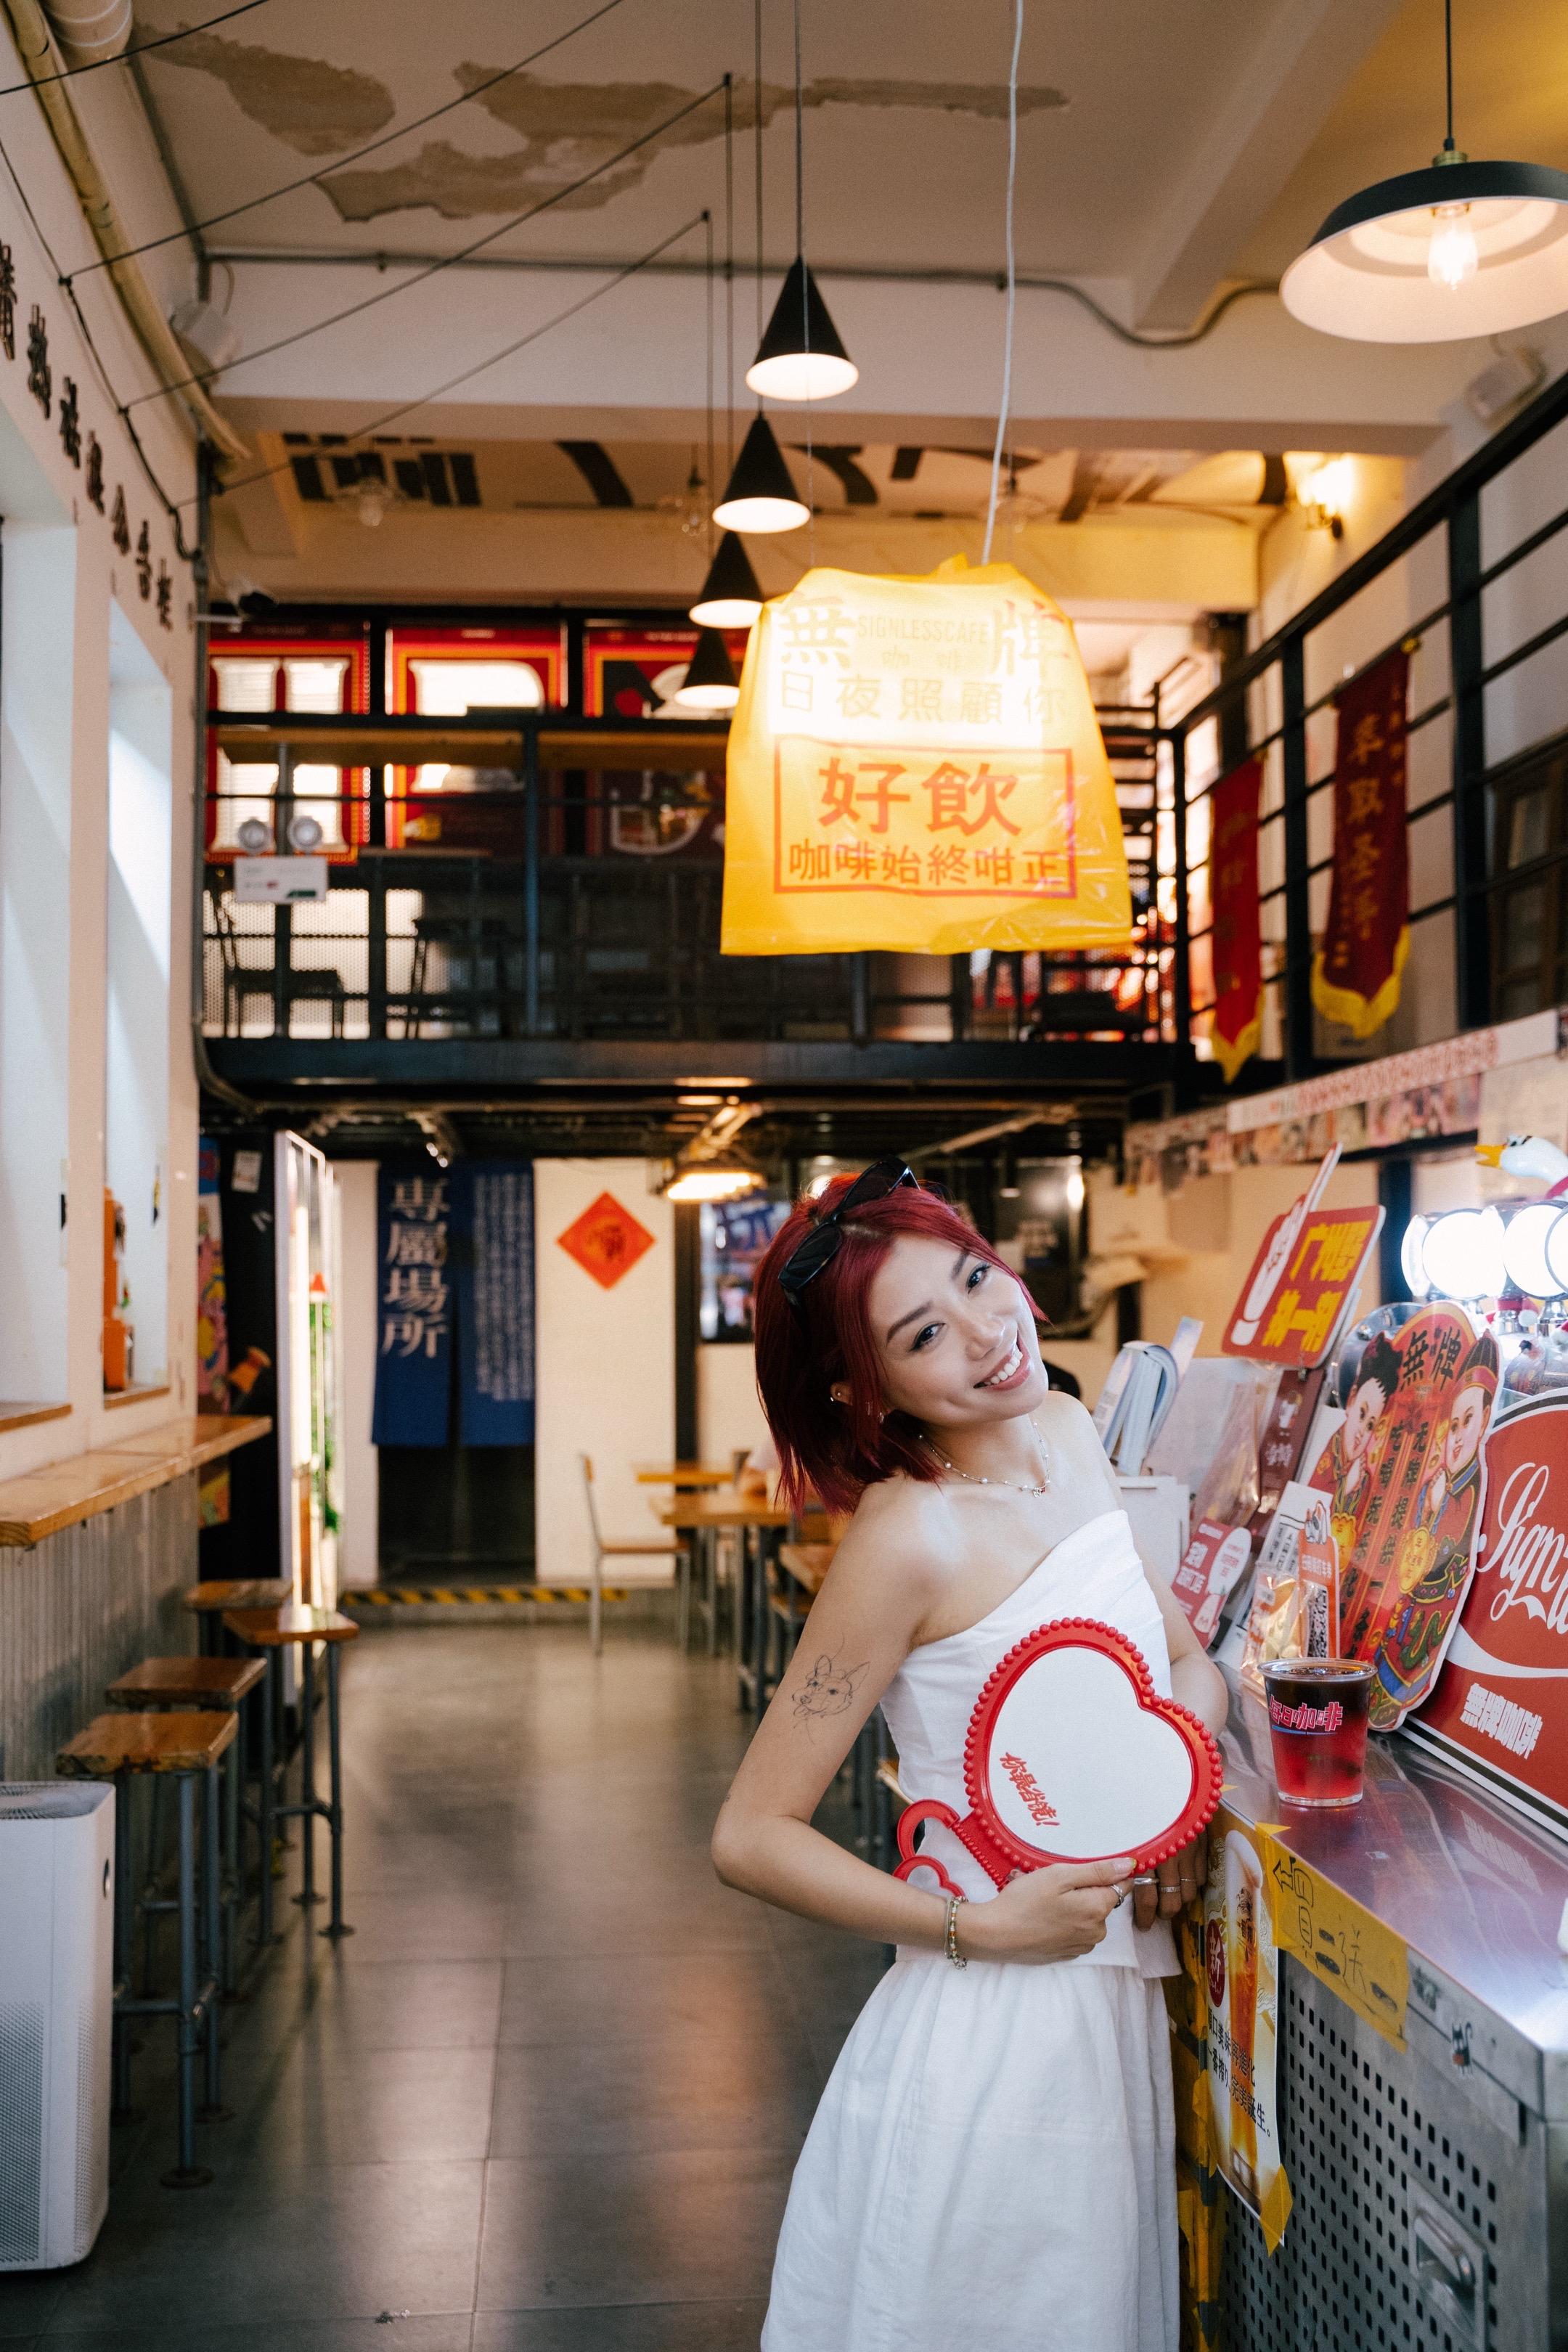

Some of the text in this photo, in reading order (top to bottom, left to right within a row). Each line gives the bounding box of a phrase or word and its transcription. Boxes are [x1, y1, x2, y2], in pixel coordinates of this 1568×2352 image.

[780, 669, 1065, 724] 日夜照顧你
[818, 756, 1021, 836] 好飲
[788, 841, 1064, 888] 咖啡始終咁正
[1400, 1326, 1461, 1392] 無牌
[1269, 1694, 1343, 1731] 每日咖啡
